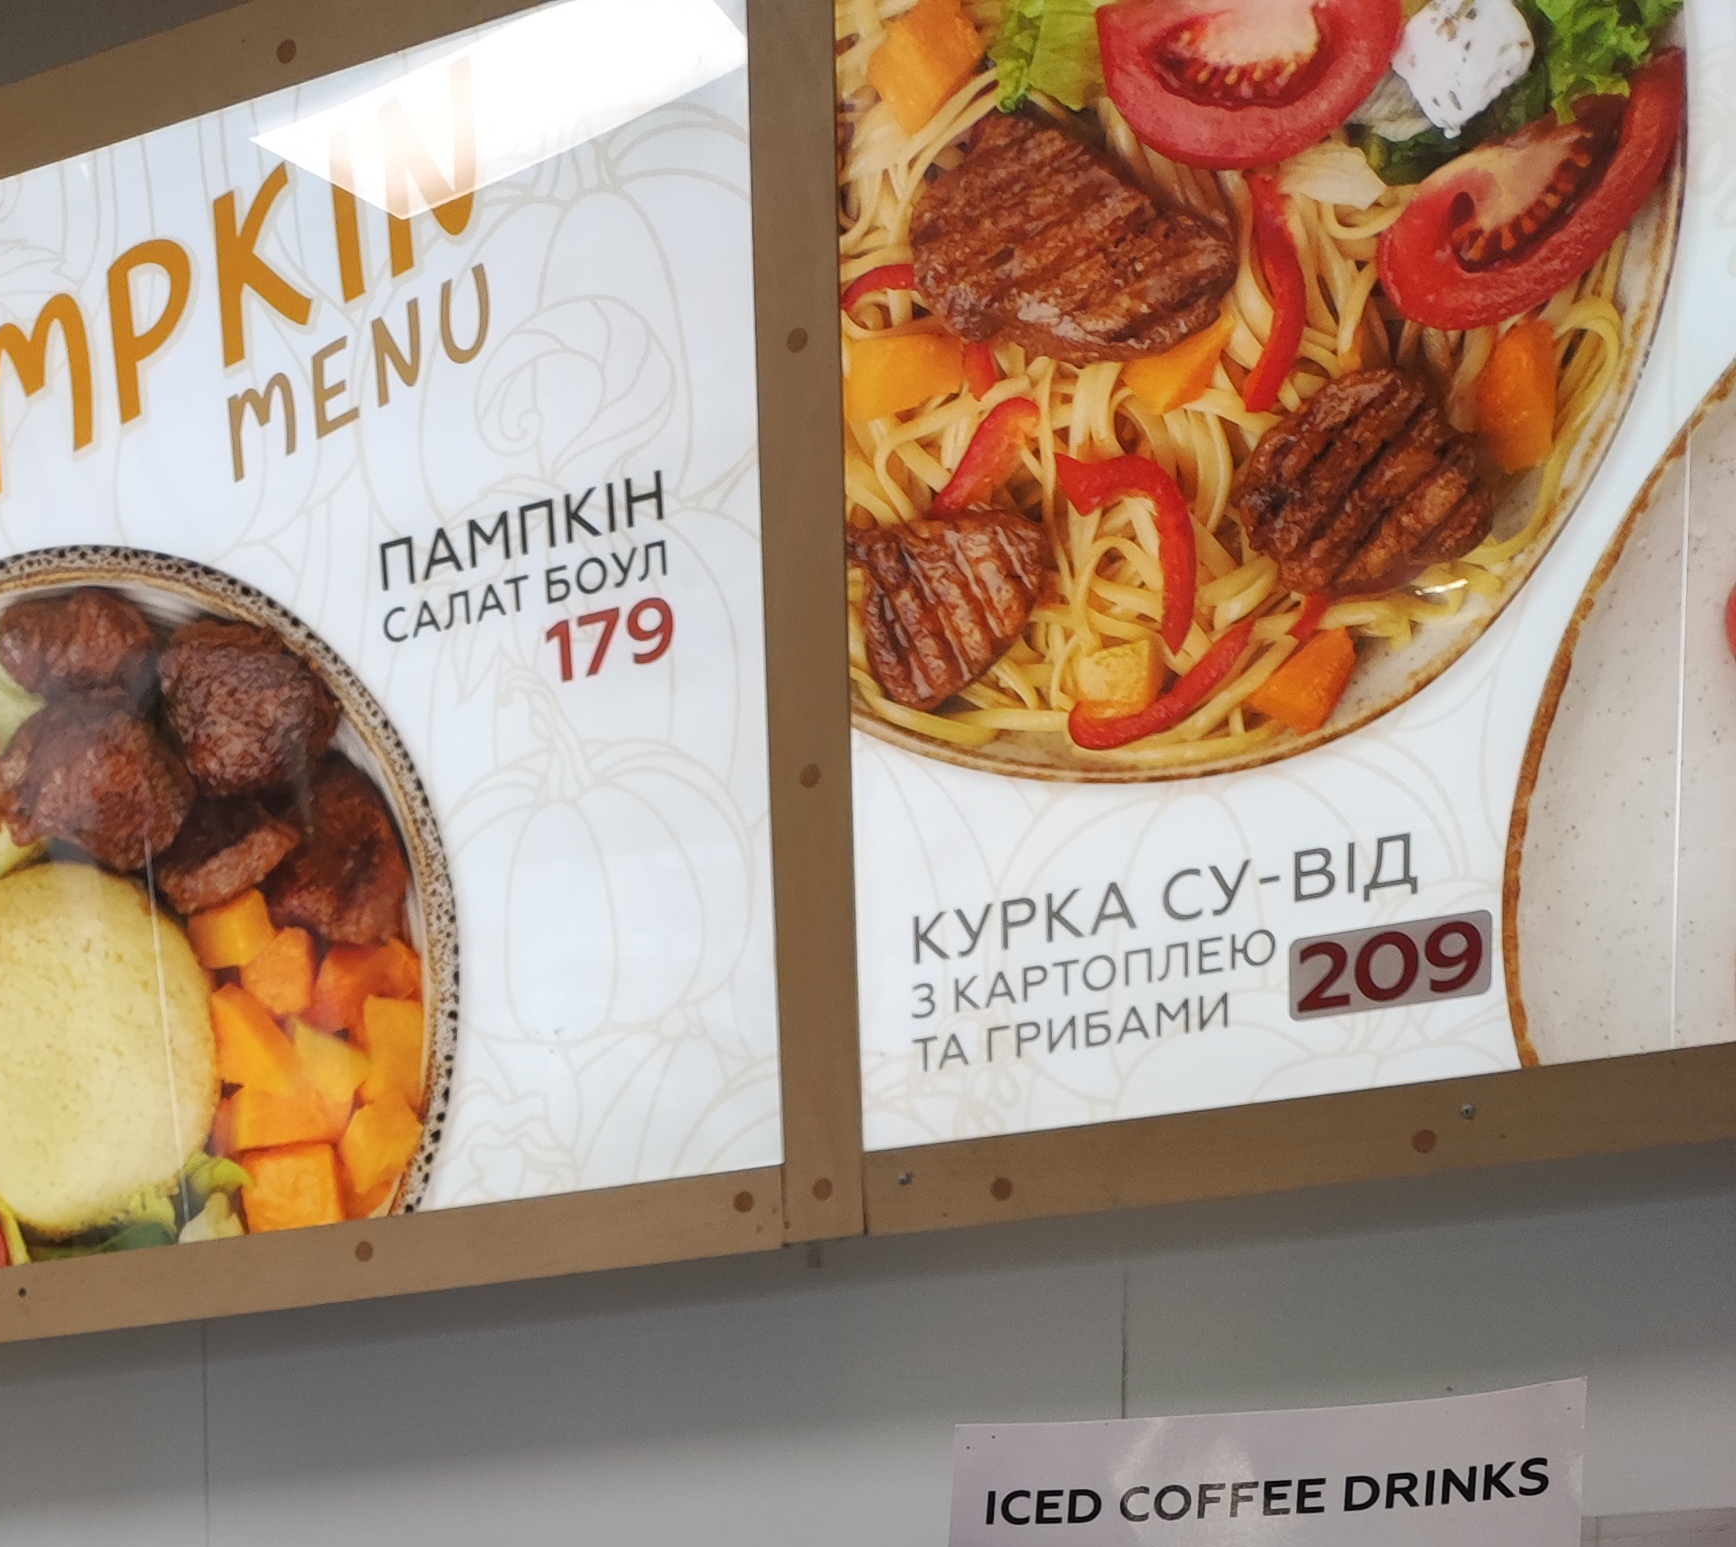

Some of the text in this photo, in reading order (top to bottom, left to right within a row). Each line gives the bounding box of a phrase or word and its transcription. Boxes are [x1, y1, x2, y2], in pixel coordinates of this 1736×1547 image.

[225, 262, 491, 483] MENU
[379, 469, 665, 591] ПАМПКІН
[383, 539, 667, 643] САЛАТ БОУЛ
[545, 597, 674, 682] 179
[912, 832, 1419, 964] КУРКА СУ-ВІД
[912, 920, 1484, 1020] З КАРТОПЛЕЮ 209
[913, 991, 1230, 1073] ТА ГРИБАМИ
[985, 1456, 1551, 1526] ICED COFFEE DRINKS
